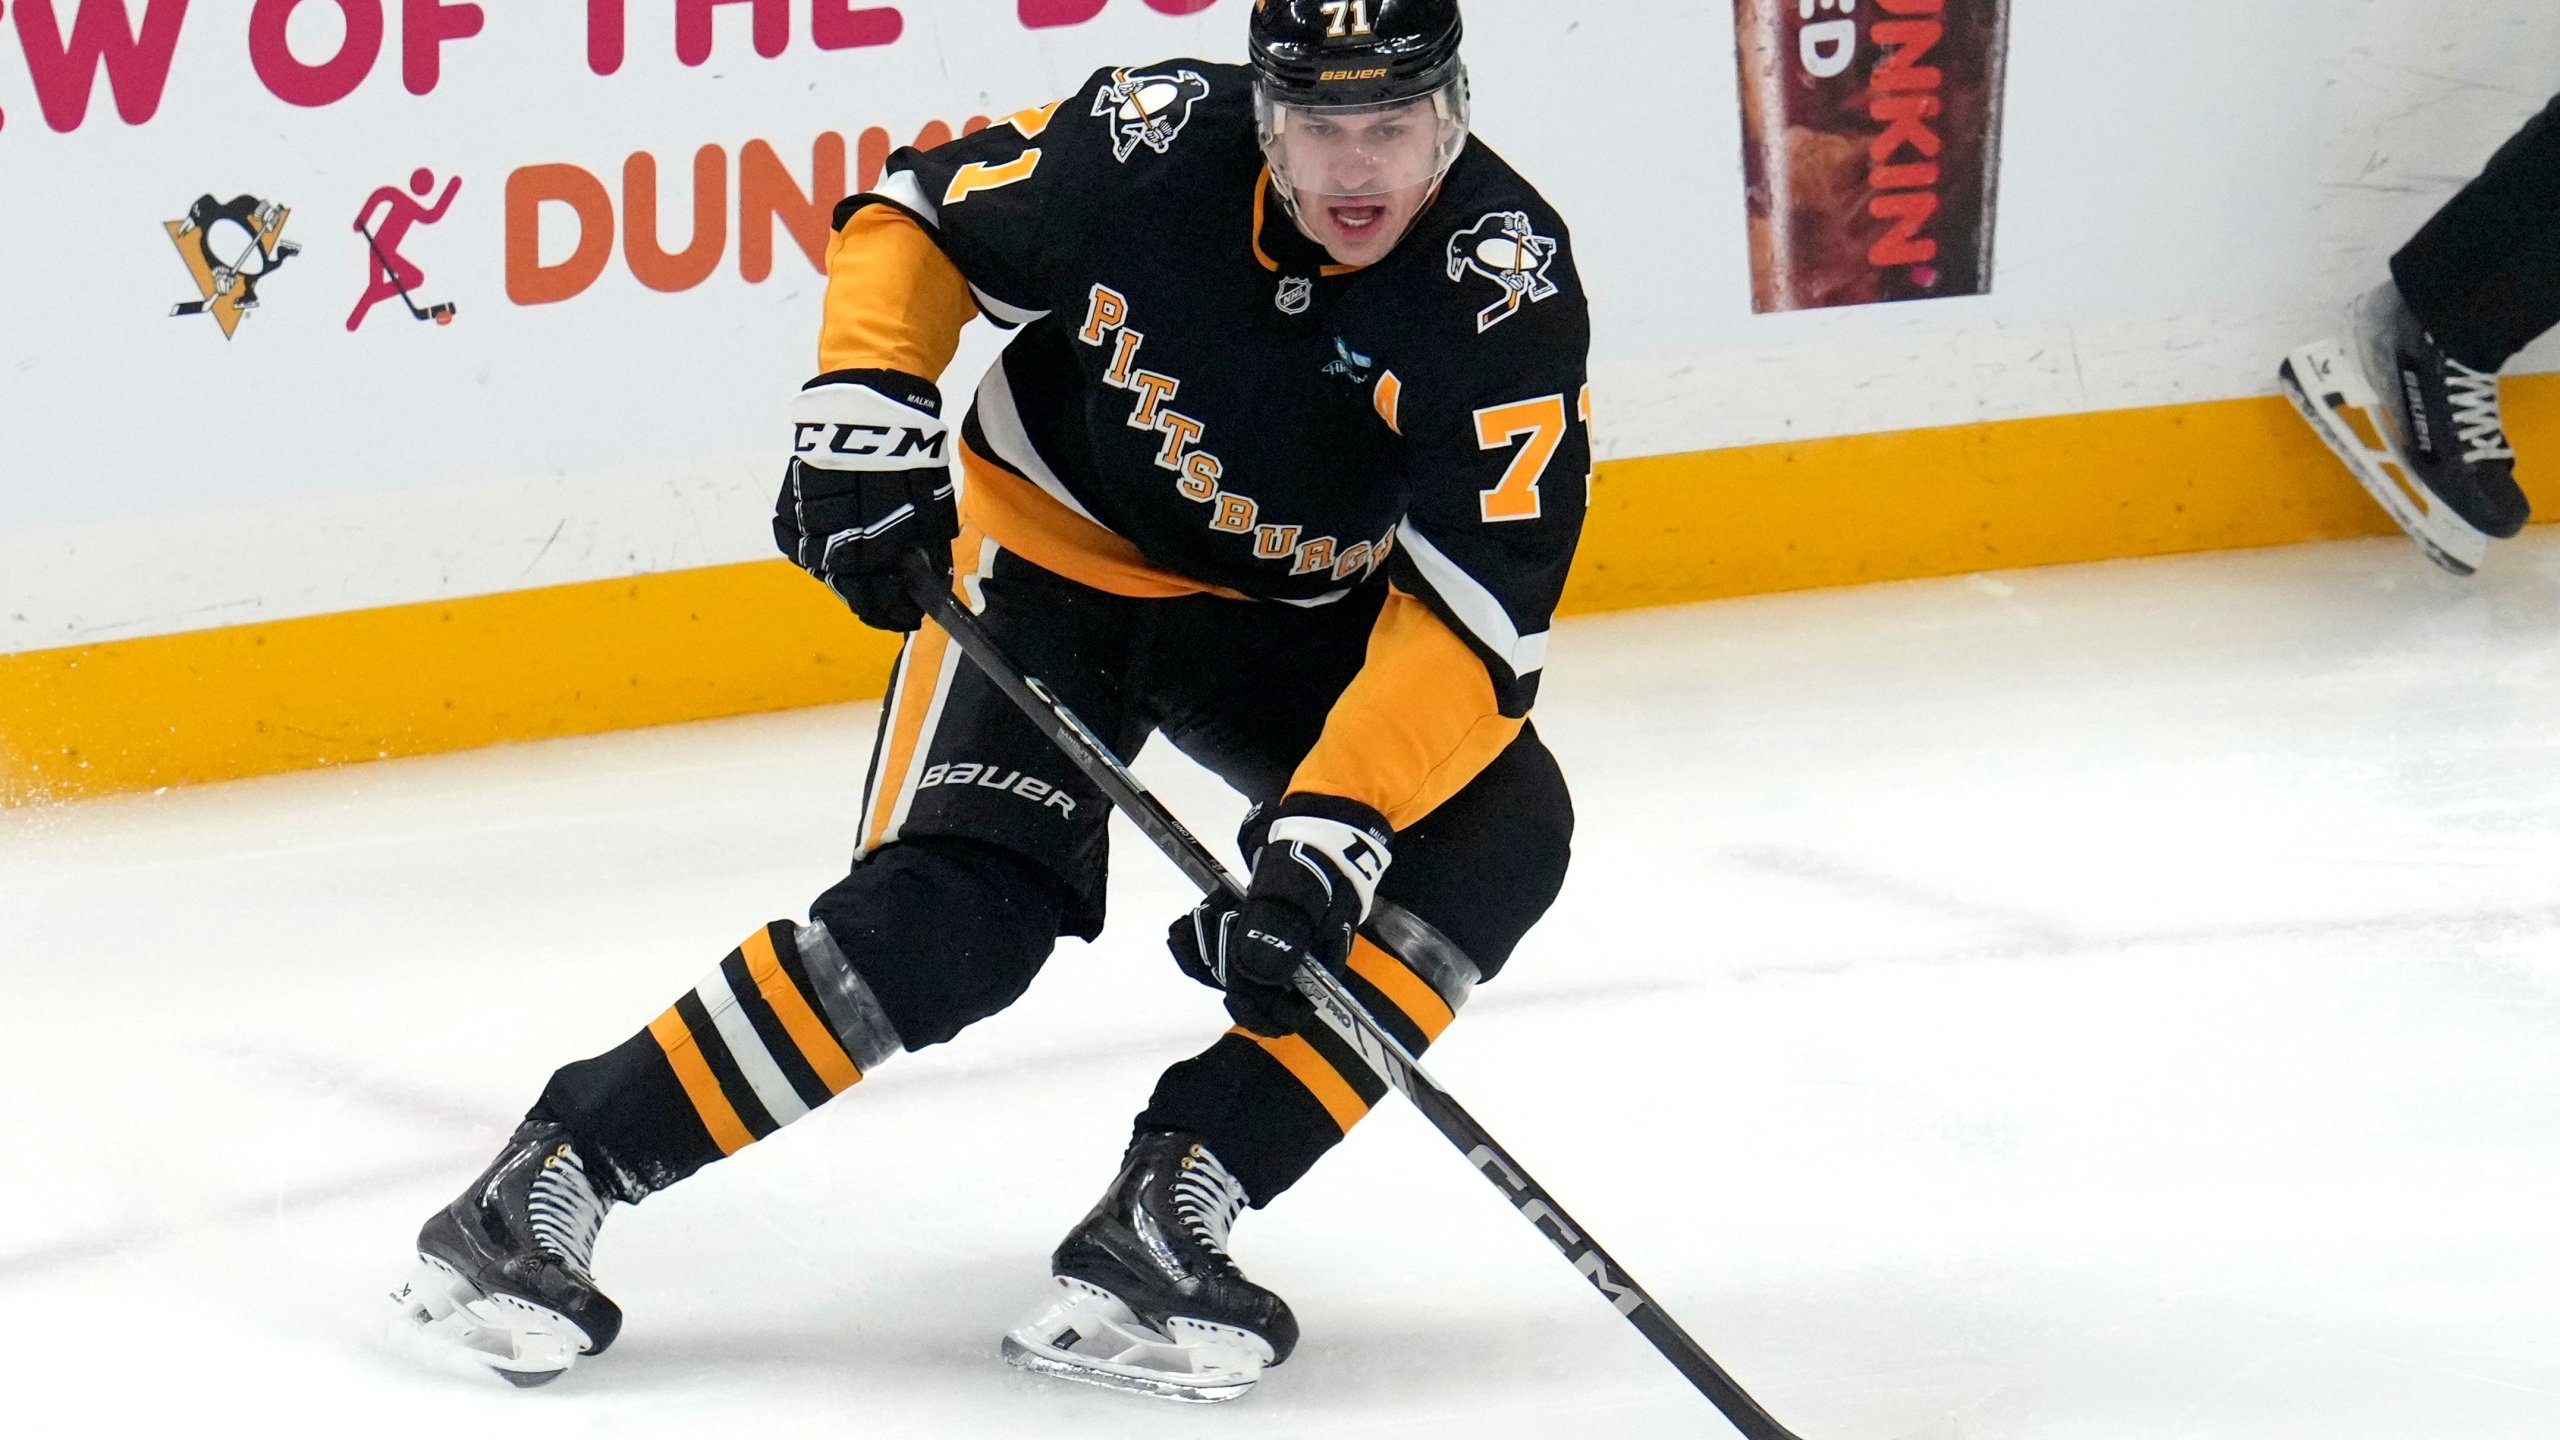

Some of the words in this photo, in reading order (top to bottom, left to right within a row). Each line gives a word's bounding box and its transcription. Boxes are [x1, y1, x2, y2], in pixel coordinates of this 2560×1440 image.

[1320, 0, 1371, 38] 71
[249, 0, 485, 107] OF
[1319, 68, 1388, 81] BAUER
[906, 393, 936, 409] MALKIN
[794, 422, 947, 459] CCM
[1078, 282, 1397, 583] PITTSBURGH
[917, 761, 1077, 820] BAUER
[1246, 929, 1293, 952] CCM
[1325, 997, 1352, 1029] PRO
[1467, 1143, 1644, 1317] CCM
